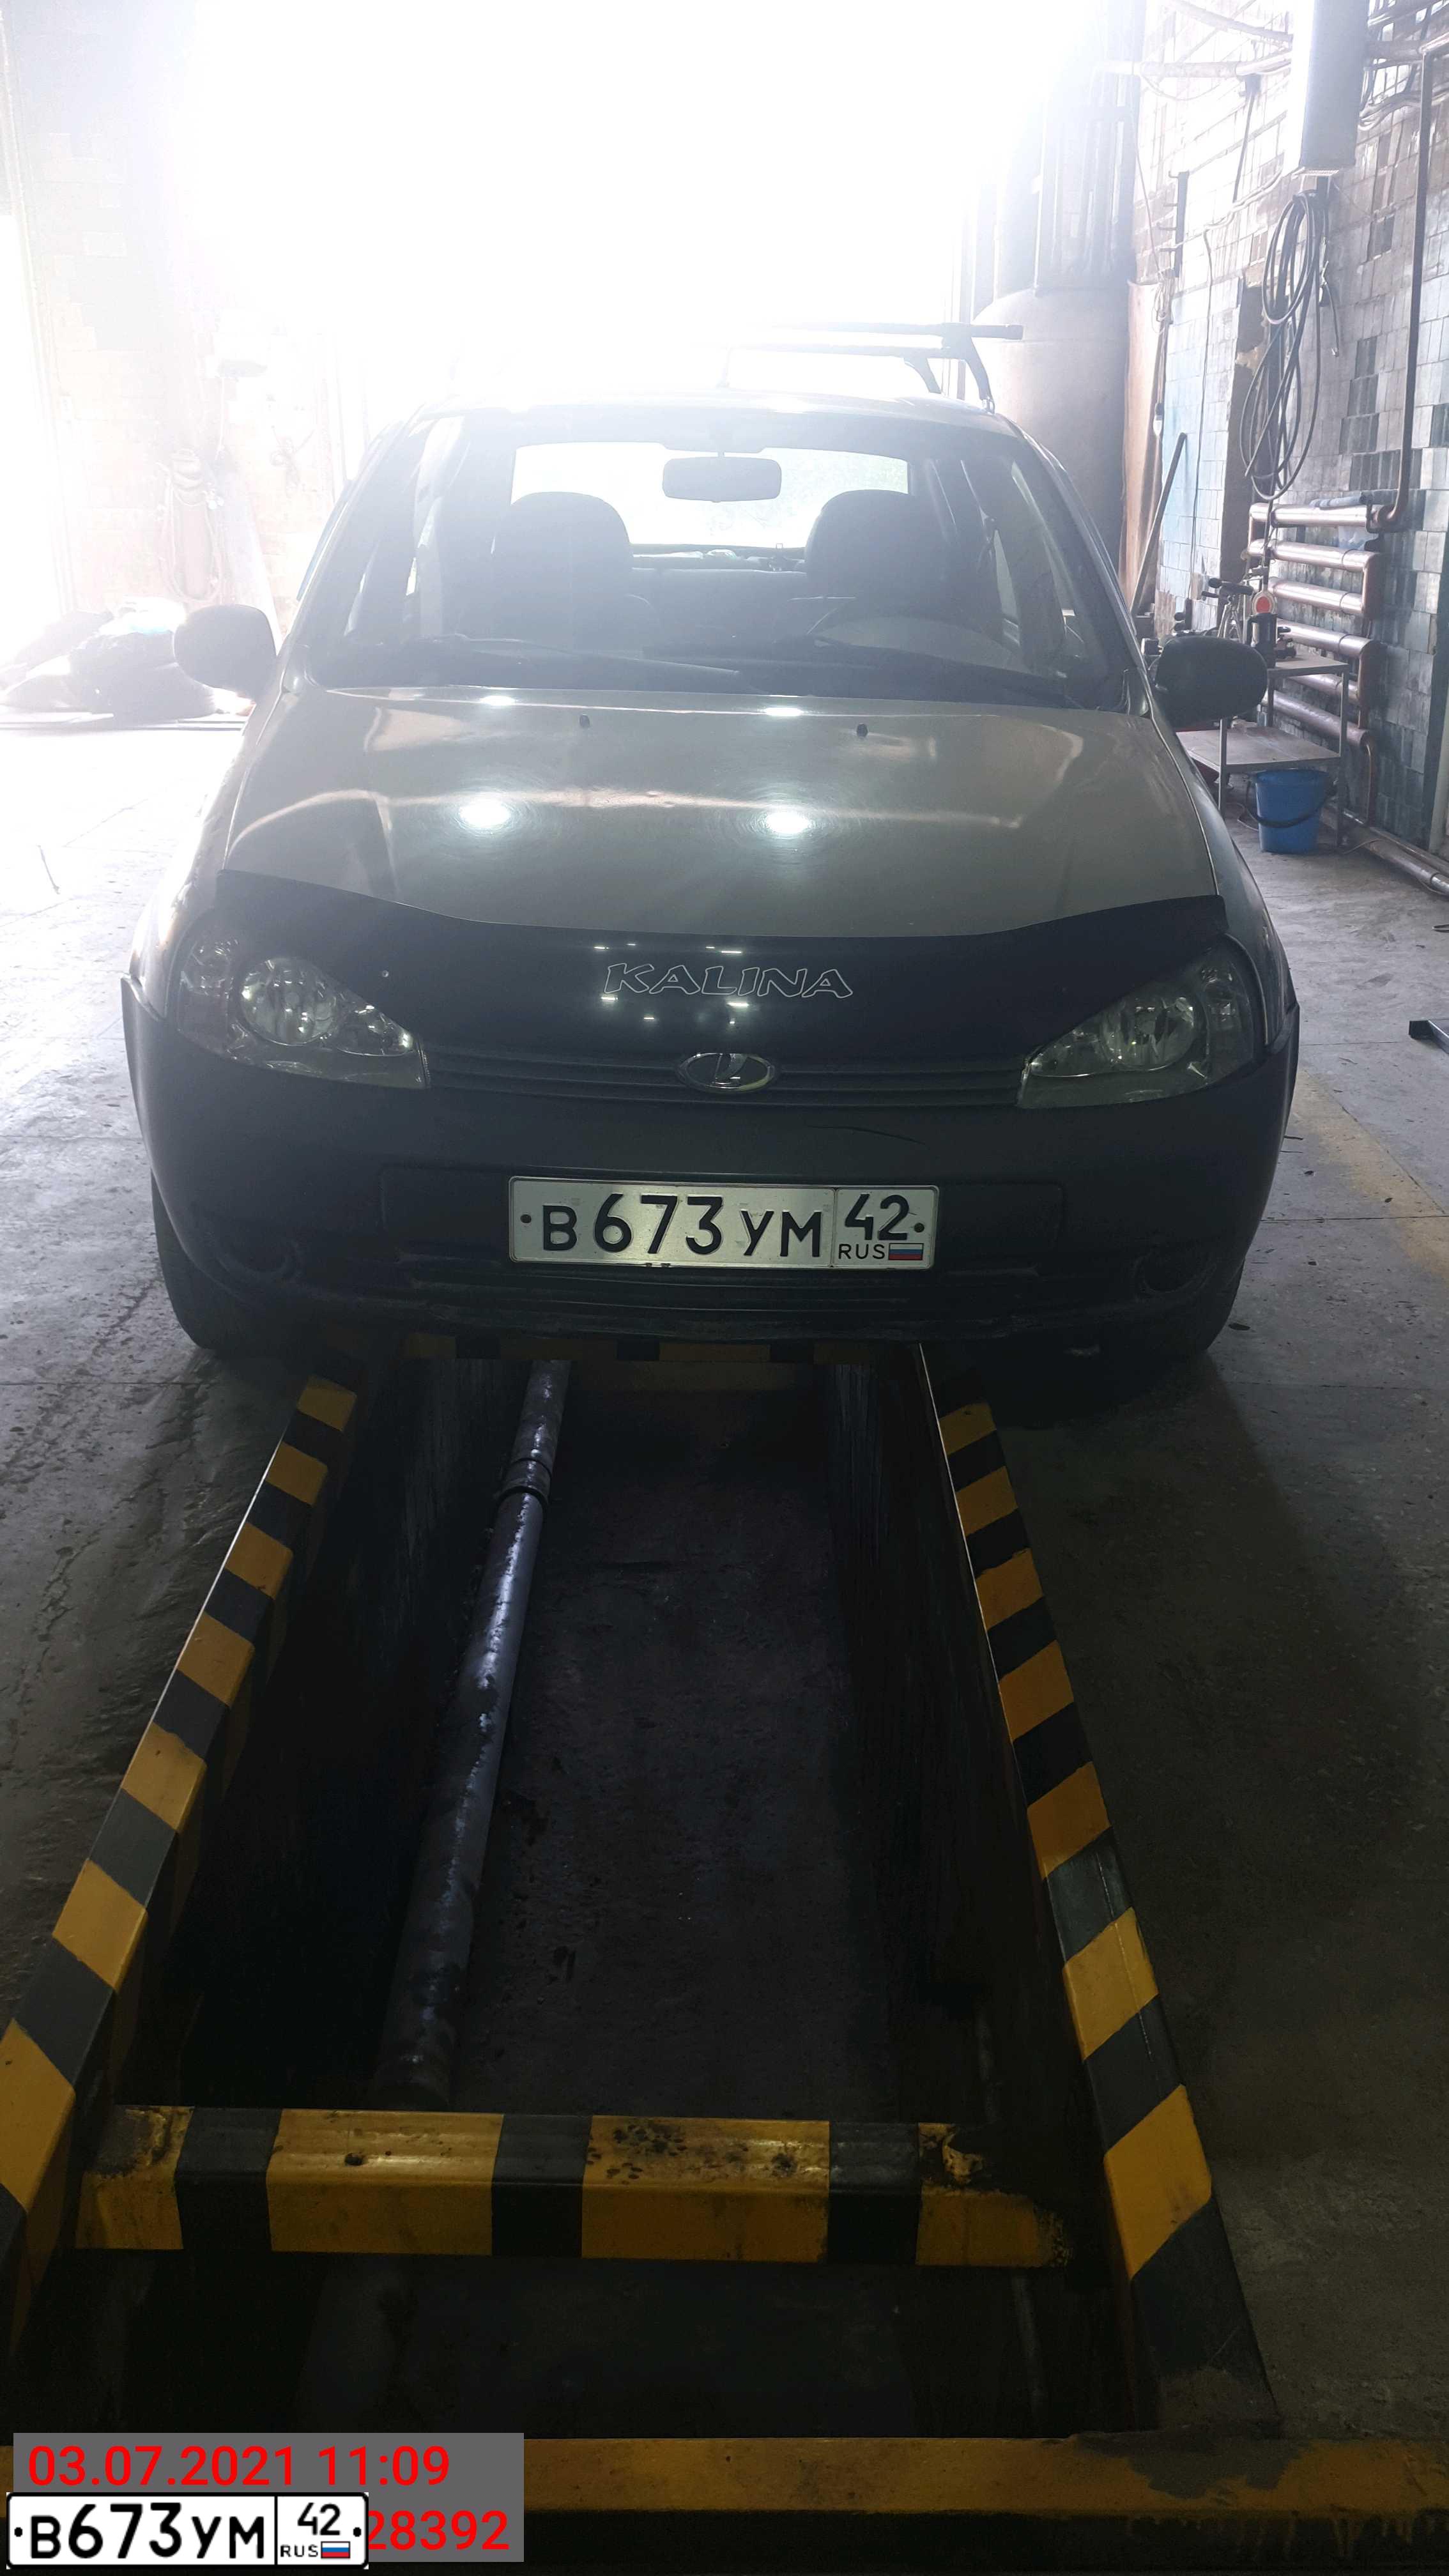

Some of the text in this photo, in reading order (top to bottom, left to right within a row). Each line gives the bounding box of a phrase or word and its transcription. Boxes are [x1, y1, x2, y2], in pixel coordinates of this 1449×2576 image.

[604, 963, 853, 998] KALINA
[844, 1193, 909, 1241] 42
[838, 1243, 885, 1261] RUS
